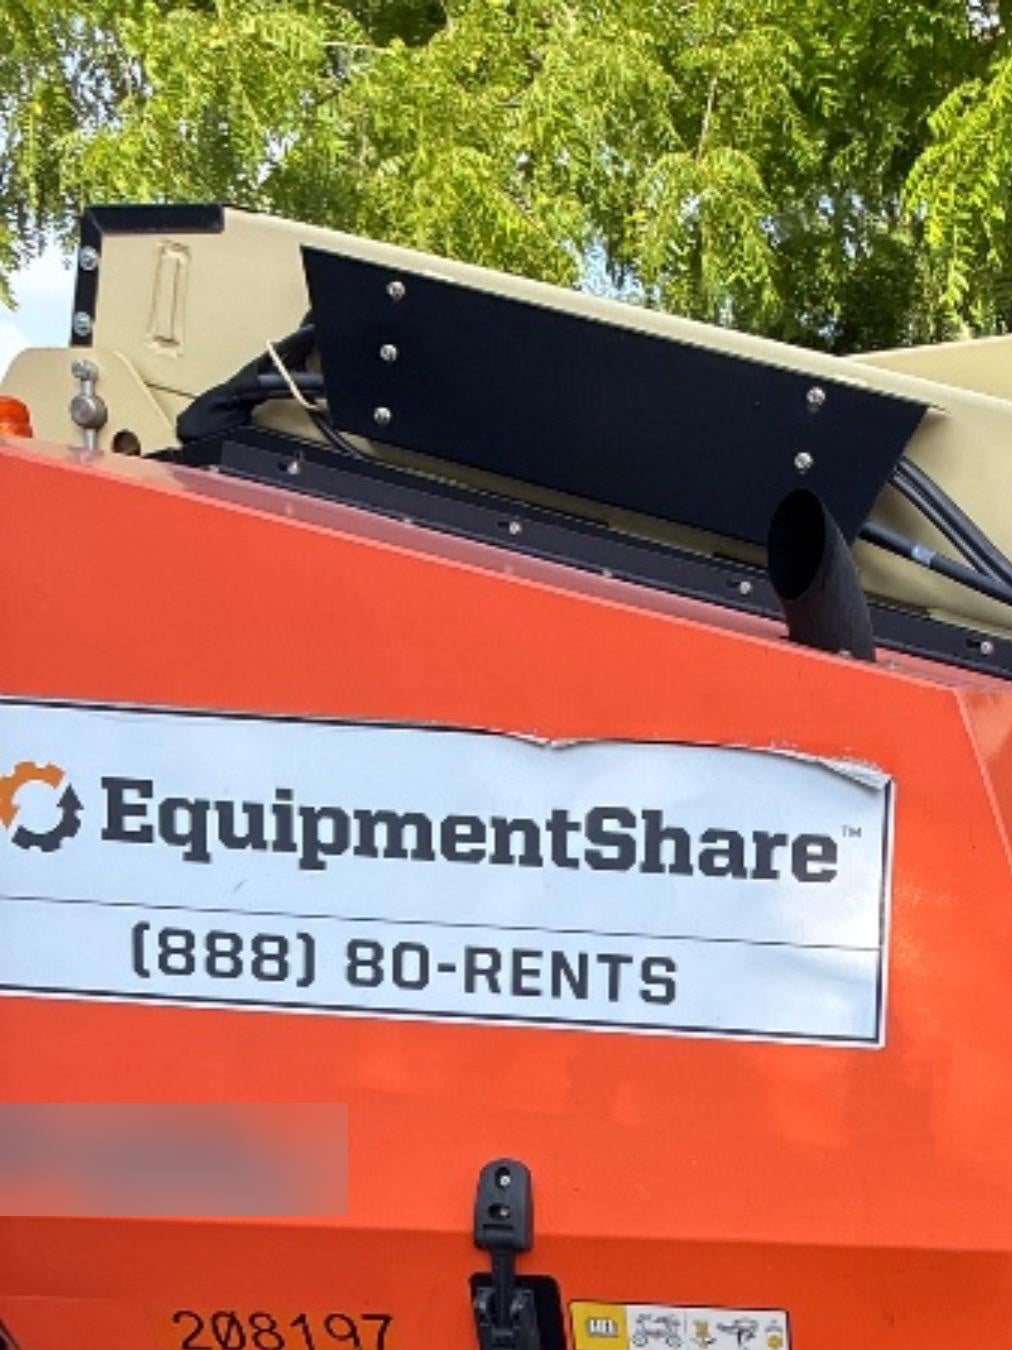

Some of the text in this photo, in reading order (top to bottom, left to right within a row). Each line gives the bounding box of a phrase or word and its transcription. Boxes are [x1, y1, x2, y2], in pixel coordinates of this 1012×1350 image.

[101, 776, 838, 883] EquipmentShare
[132, 921, 676, 1006] (888) 80-RENTS
